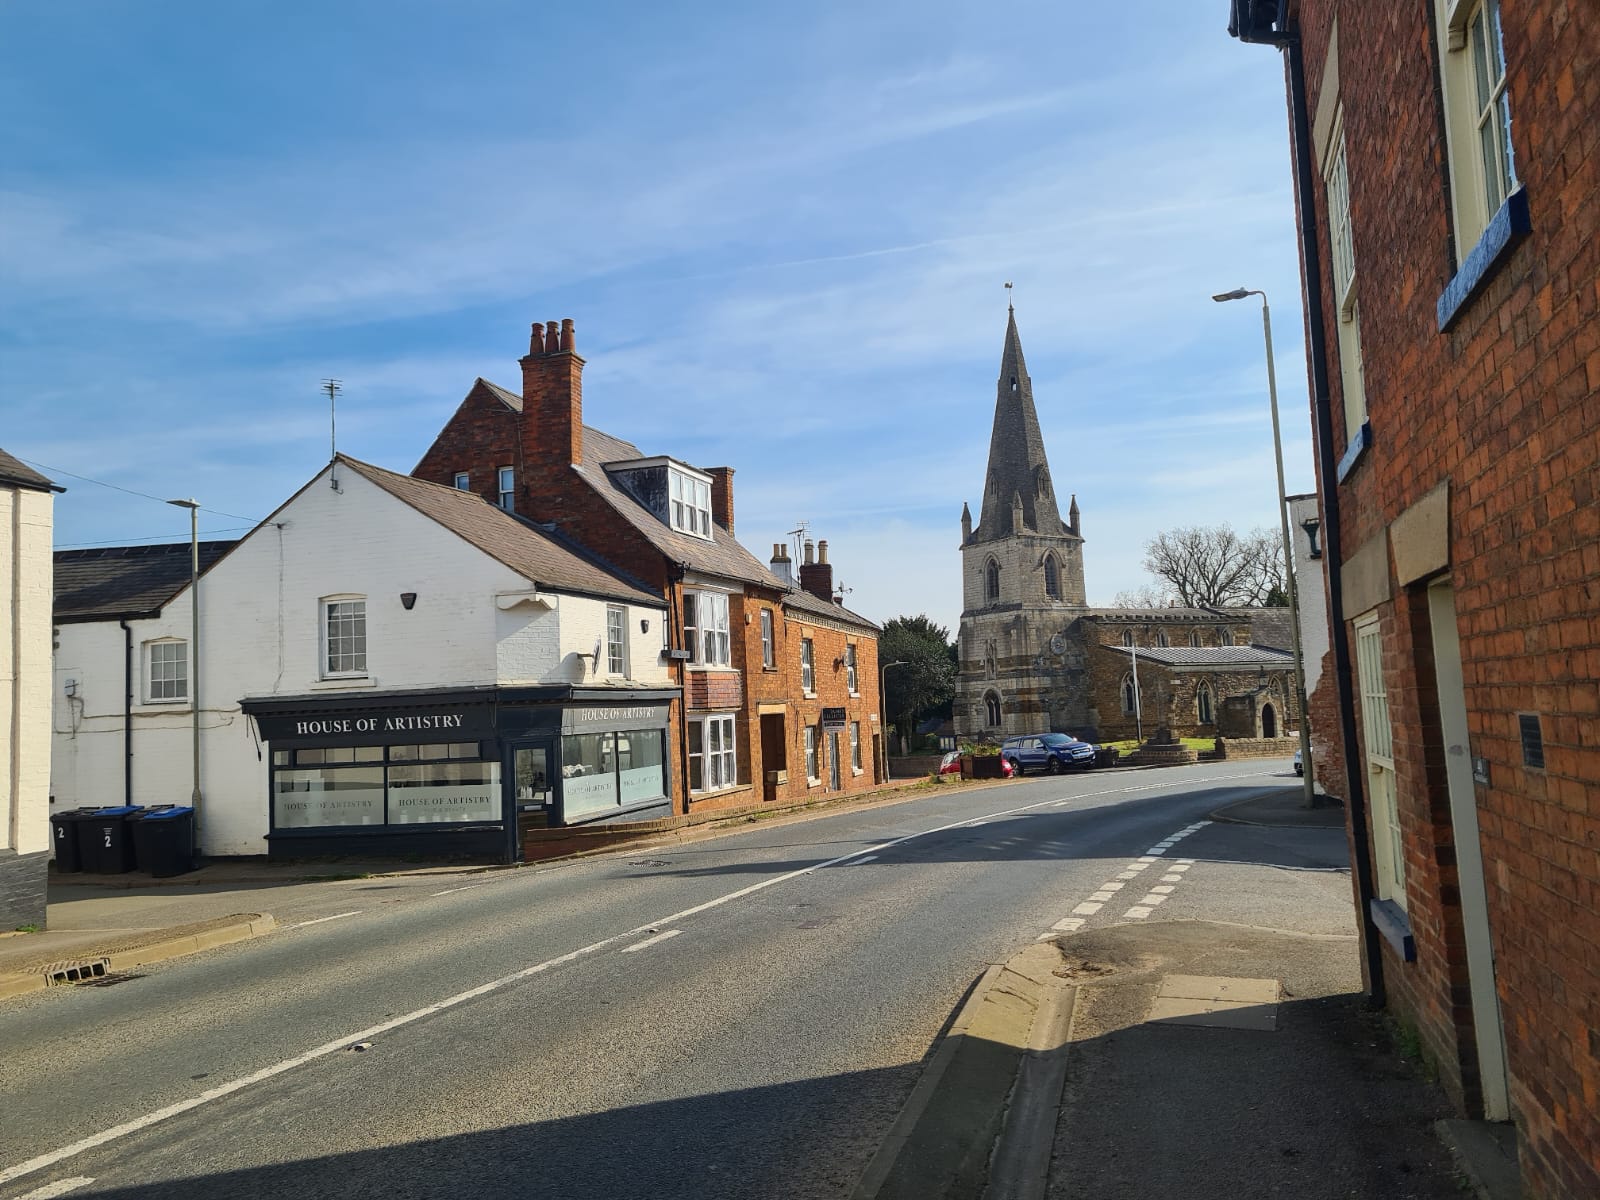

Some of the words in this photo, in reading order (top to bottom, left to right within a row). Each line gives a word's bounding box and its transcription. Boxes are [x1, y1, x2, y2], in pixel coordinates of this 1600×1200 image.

[582, 708, 609, 720] HOUSE
[610, 707, 620, 720] OF
[623, 707, 656, 719] ARTISTRY
[296, 719, 352, 735] HOUSE
[356, 718, 378, 732] OF
[383, 714, 464, 731] ARTISTRY
[329, 800, 374, 809] ARTISTRY
[399, 799, 430, 807] HOUSE
[446, 796, 491, 805] ARTISTRY
[58, 827, 65, 838] 2
[104, 836, 111, 847] 2
